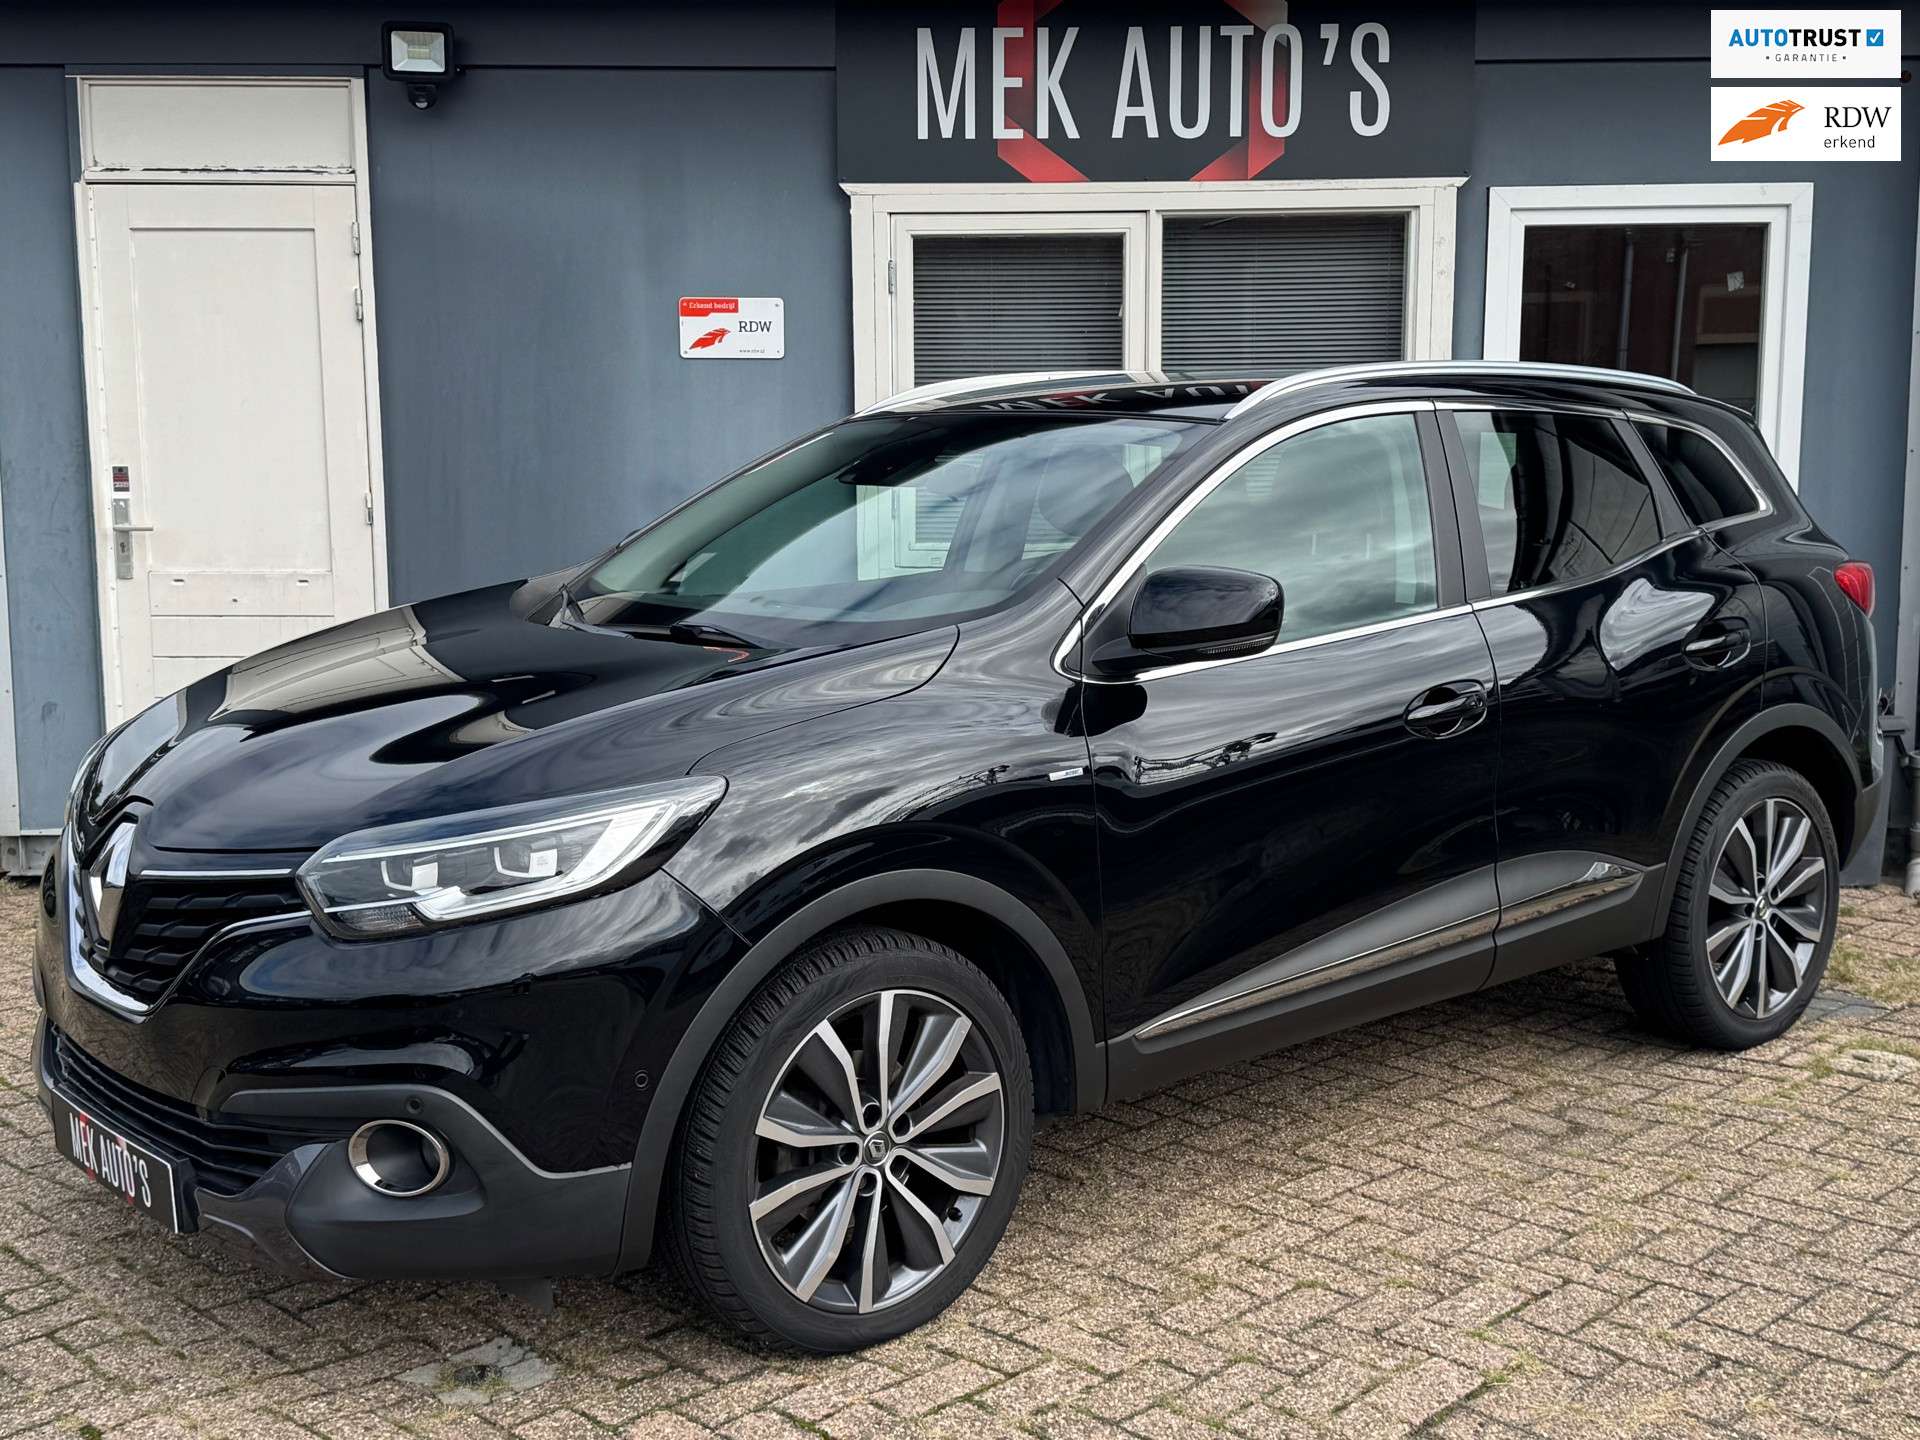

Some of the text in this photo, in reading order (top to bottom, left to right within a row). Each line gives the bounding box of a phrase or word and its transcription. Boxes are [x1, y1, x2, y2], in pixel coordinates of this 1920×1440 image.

[917, 22, 1391, 140] MEK AUTO'S
[738, 320, 772, 333] RDW
[69, 1112, 151, 1208] MEK AUTO'S
